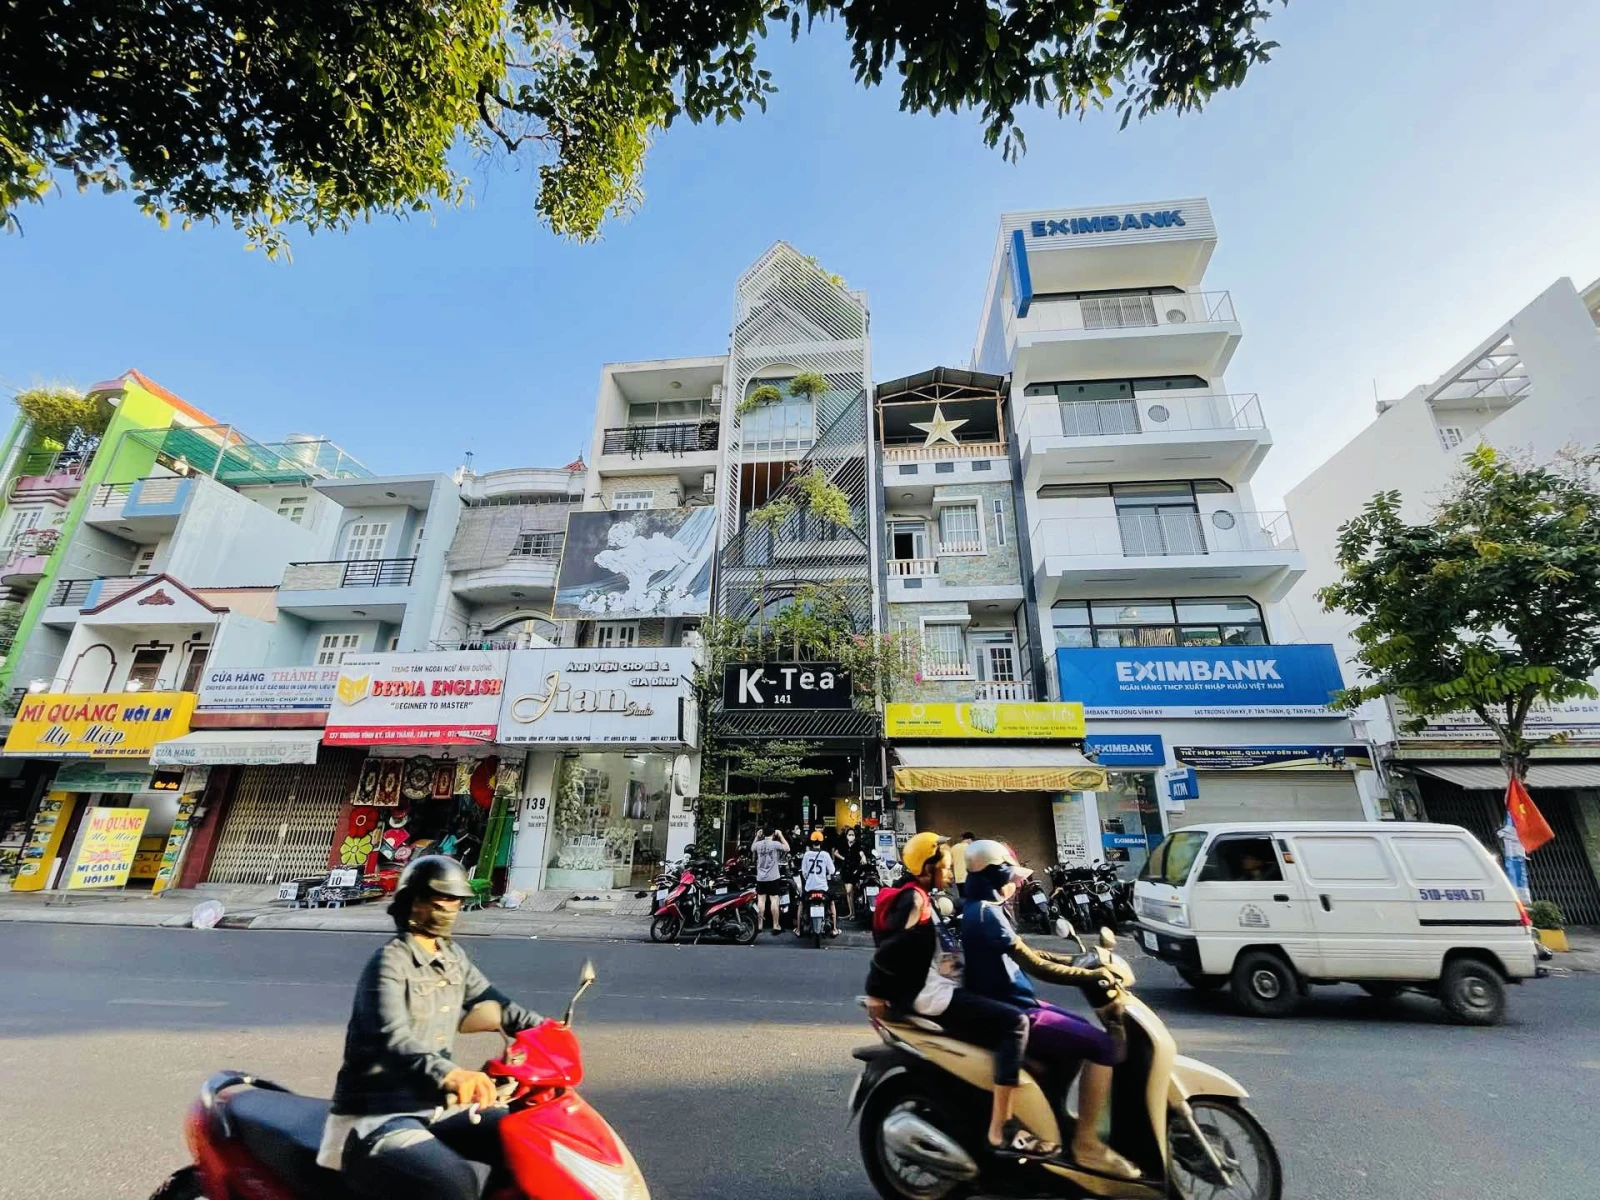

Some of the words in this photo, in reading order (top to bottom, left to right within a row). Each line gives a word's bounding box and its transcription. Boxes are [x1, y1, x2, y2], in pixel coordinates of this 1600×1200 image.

[1031, 210, 1186, 237] EXIMBANK
[620, 662, 643, 671] CHO
[660, 662, 670, 671] &
[1115, 659, 1281, 682] EXIMBANK
[371, 680, 426, 696] BETMA
[430, 679, 503, 696] ENGLISH
[628, 678, 649, 687] GIA
[739, 668, 835, 703] K-Tea
[1119, 683, 1141, 691] NGÂN
[1141, 683, 1162, 691] HÀNG
[1184, 682, 1203, 690] XUẤT
[1205, 683, 1225, 691] NHẬP
[511, 669, 627, 723] Jian
[774, 695, 791, 704] 141
[47, 697, 119, 725] QUẢNG
[122, 706, 149, 723] HỘI
[152, 707, 173, 722] AN
[1173, 782, 1188, 796] ATM
[526, 797, 546, 810] 139
[808, 859, 823, 875] 25
[331, 876, 342, 886] 10
[280, 889, 289, 899] 10
